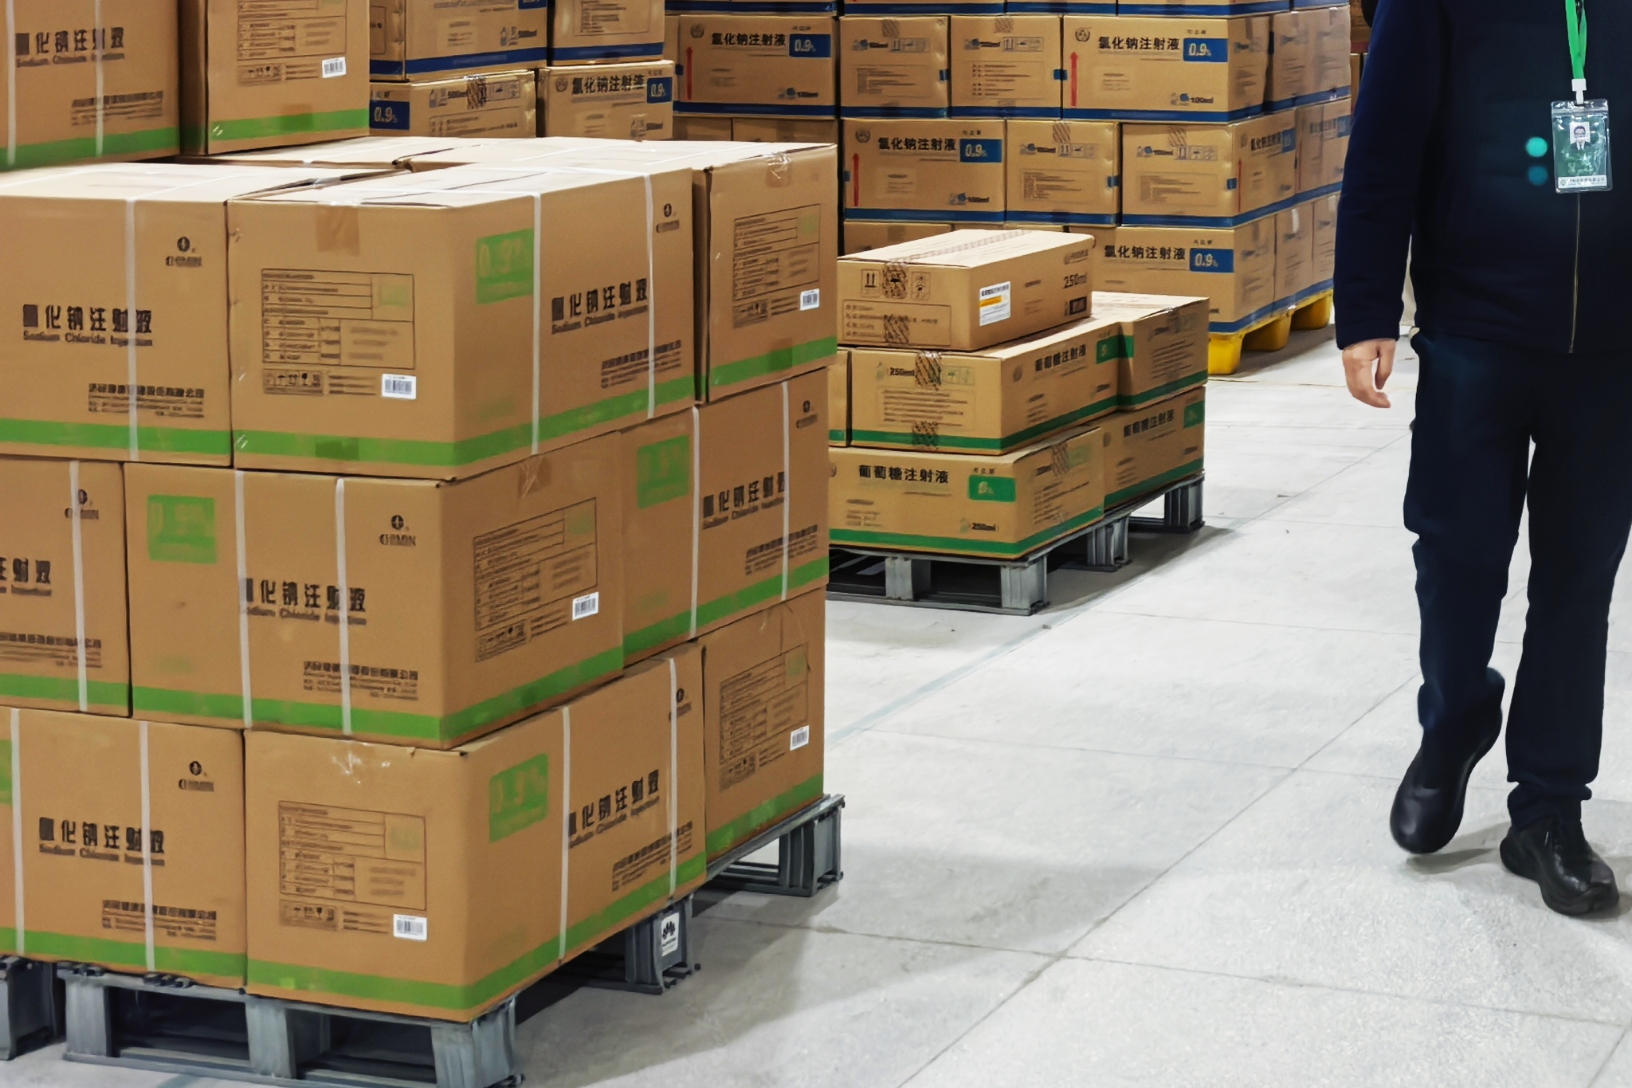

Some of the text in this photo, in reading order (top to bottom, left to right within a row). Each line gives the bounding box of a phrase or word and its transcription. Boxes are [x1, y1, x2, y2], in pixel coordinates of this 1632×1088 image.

[1098, 36, 1181, 51] 氯化钠注射液
[877, 138, 956, 151] 氯化钠注射液
[1104, 245, 1185, 260] 氯化钠注射液
[859, 465, 948, 484] 葡萄糖注射液
